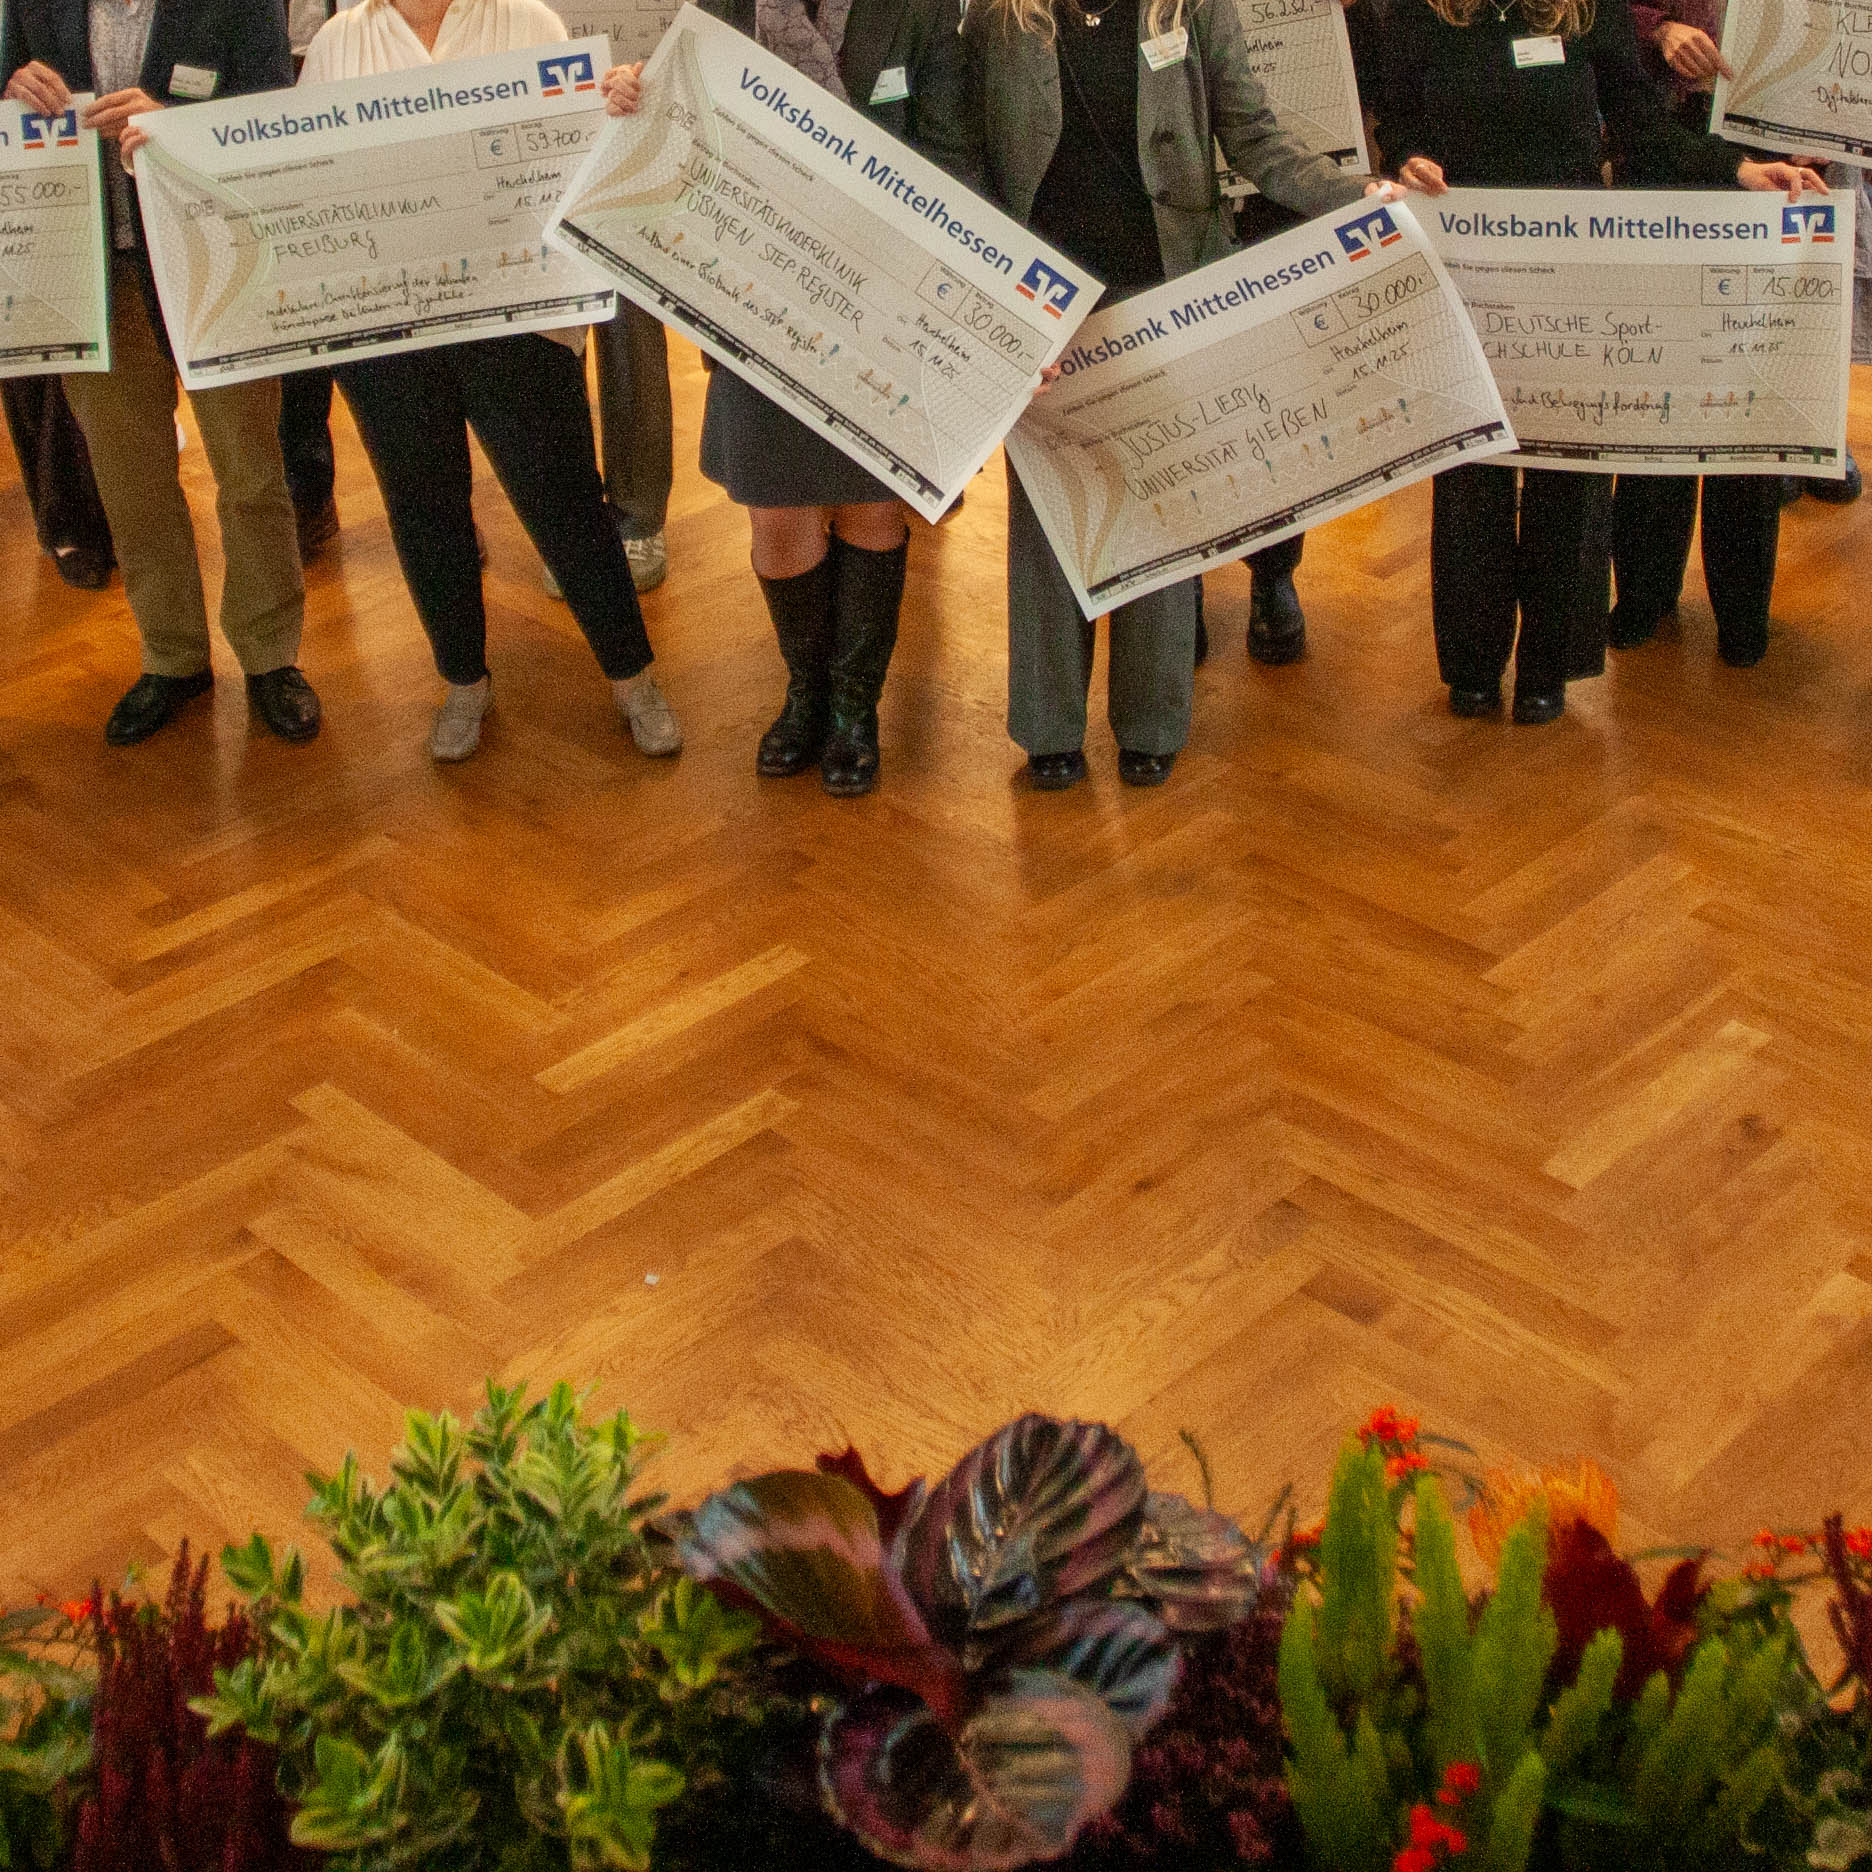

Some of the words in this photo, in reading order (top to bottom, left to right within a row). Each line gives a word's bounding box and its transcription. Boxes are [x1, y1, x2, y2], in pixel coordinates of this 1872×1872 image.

[211, 104, 348, 146] Volksbank
[356, 79, 528, 122] Mittelhessen
[489, 138, 503, 156] €
[740, 67, 857, 164] Volksbank
[861, 156, 1012, 274] Mittelhessen
[668, 178, 755, 246] TÜBINGEN
[1439, 212, 1577, 237] Volksbank
[1589, 216, 1768, 239] Mittelhessen
[273, 230, 378, 265] FREIBURG
[934, 282, 952, 299] €
[1717, 277, 1731, 295] €
[1047, 317, 1167, 381] olksbank
[1169, 250, 1334, 328] Mittelhessen
[1312, 313, 1329, 330] €
[1483, 311, 1592, 336] DEUTSCHE
[1481, 340, 1589, 362] CHSCHULE
[1602, 337, 1663, 366] KÖLN
[1121, 439, 1241, 500] UNIVERSITÄT
